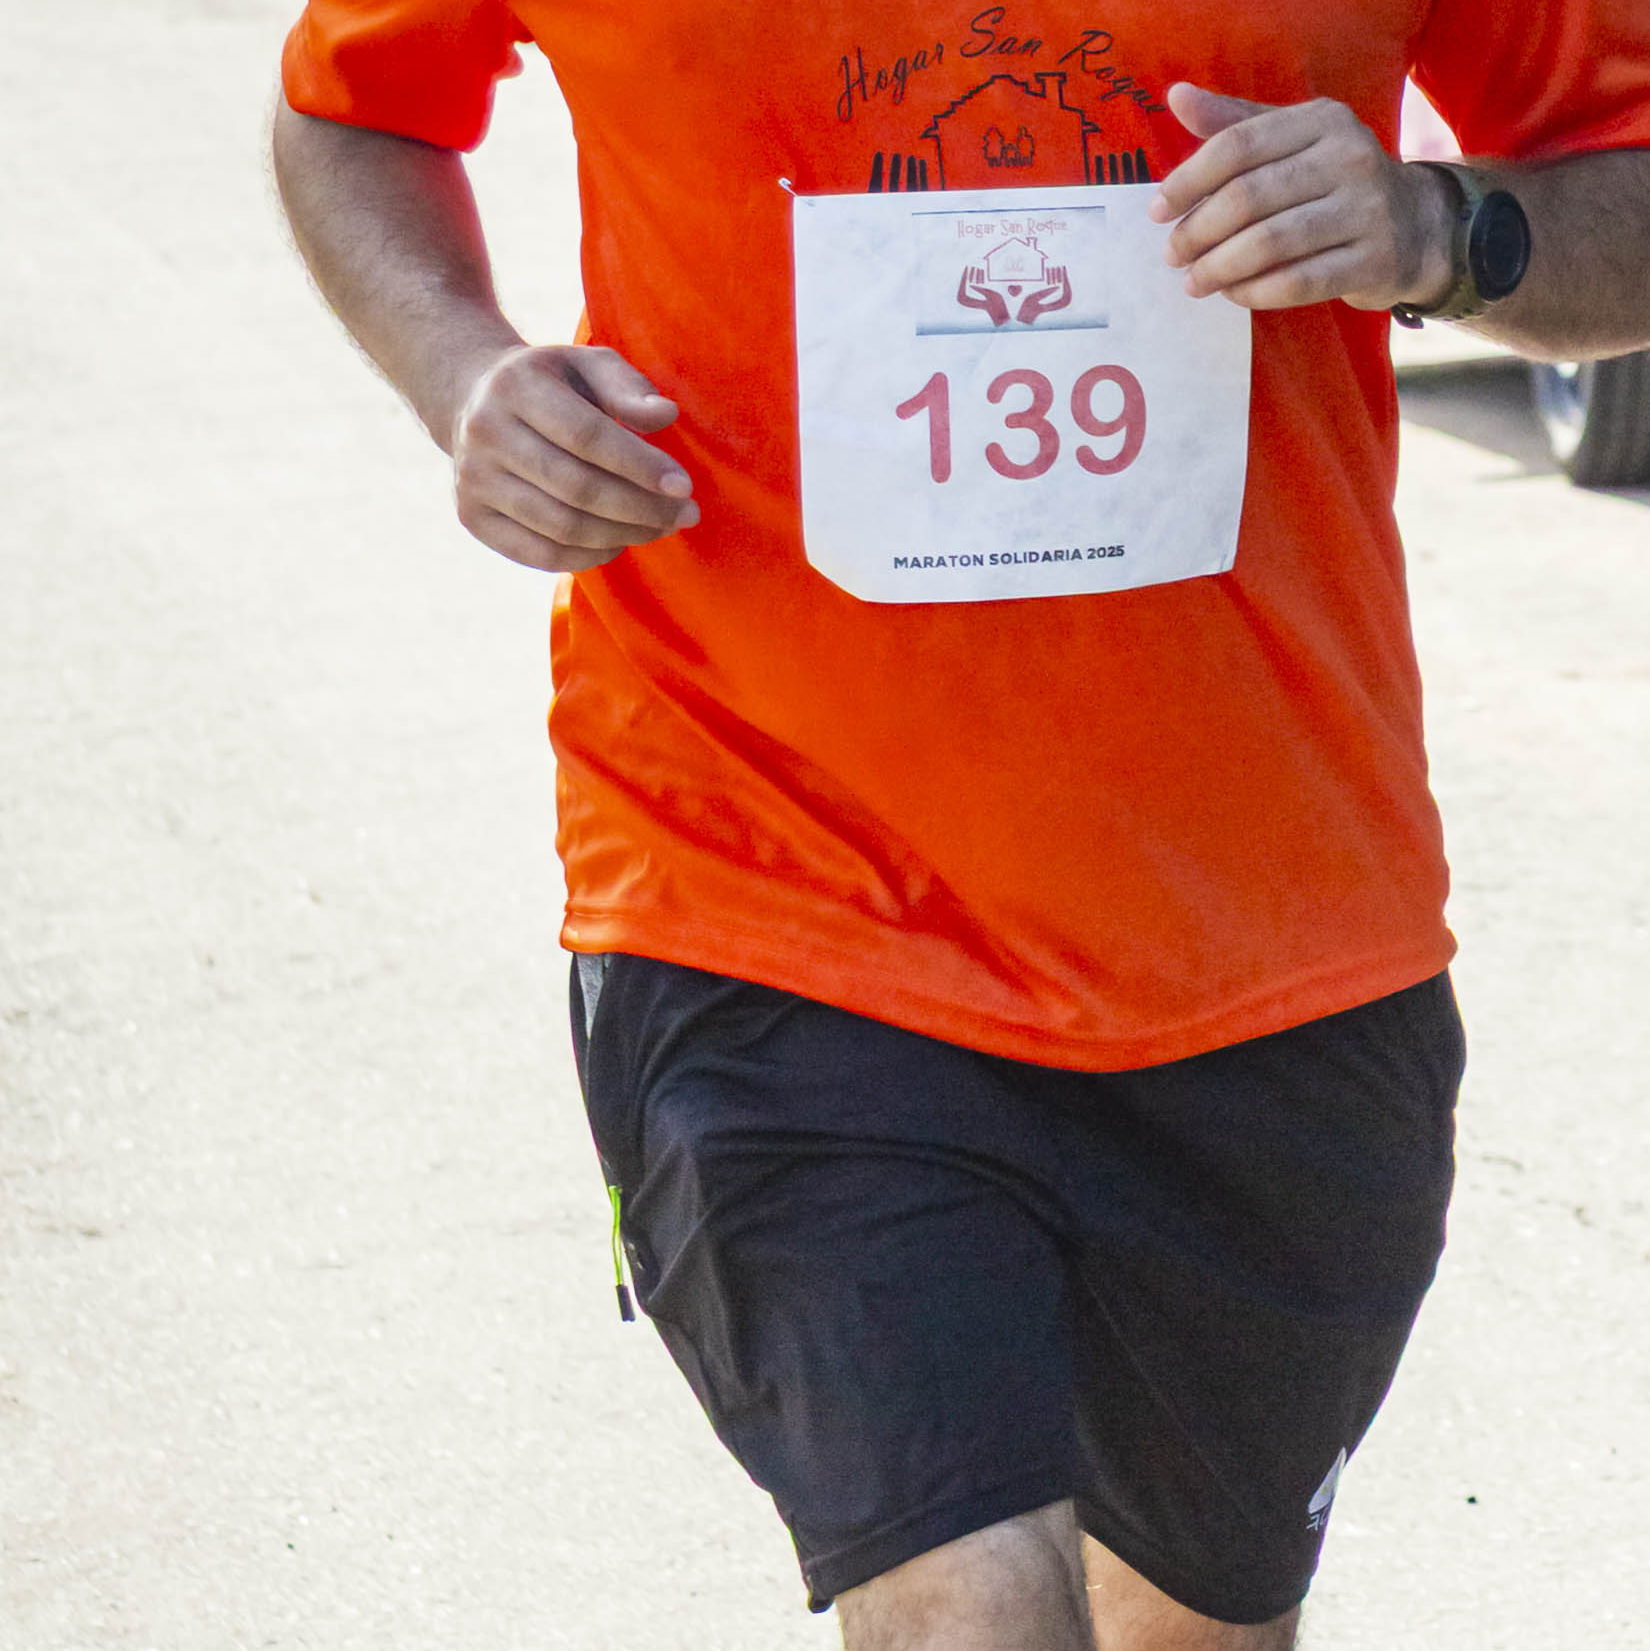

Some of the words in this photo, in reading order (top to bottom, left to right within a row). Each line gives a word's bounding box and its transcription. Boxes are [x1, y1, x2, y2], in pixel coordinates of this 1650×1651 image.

[837, 43, 944, 122] Hogar
[960, 6, 1043, 58] San
[1000, 219, 1023, 236] San
[1027, 217, 1068, 236] Roque
[896, 364, 1147, 484] 139
[894, 554, 985, 569] MARATON
[988, 549, 1083, 566] SOLIDARIA
[1087, 545, 1125, 560] 2025
